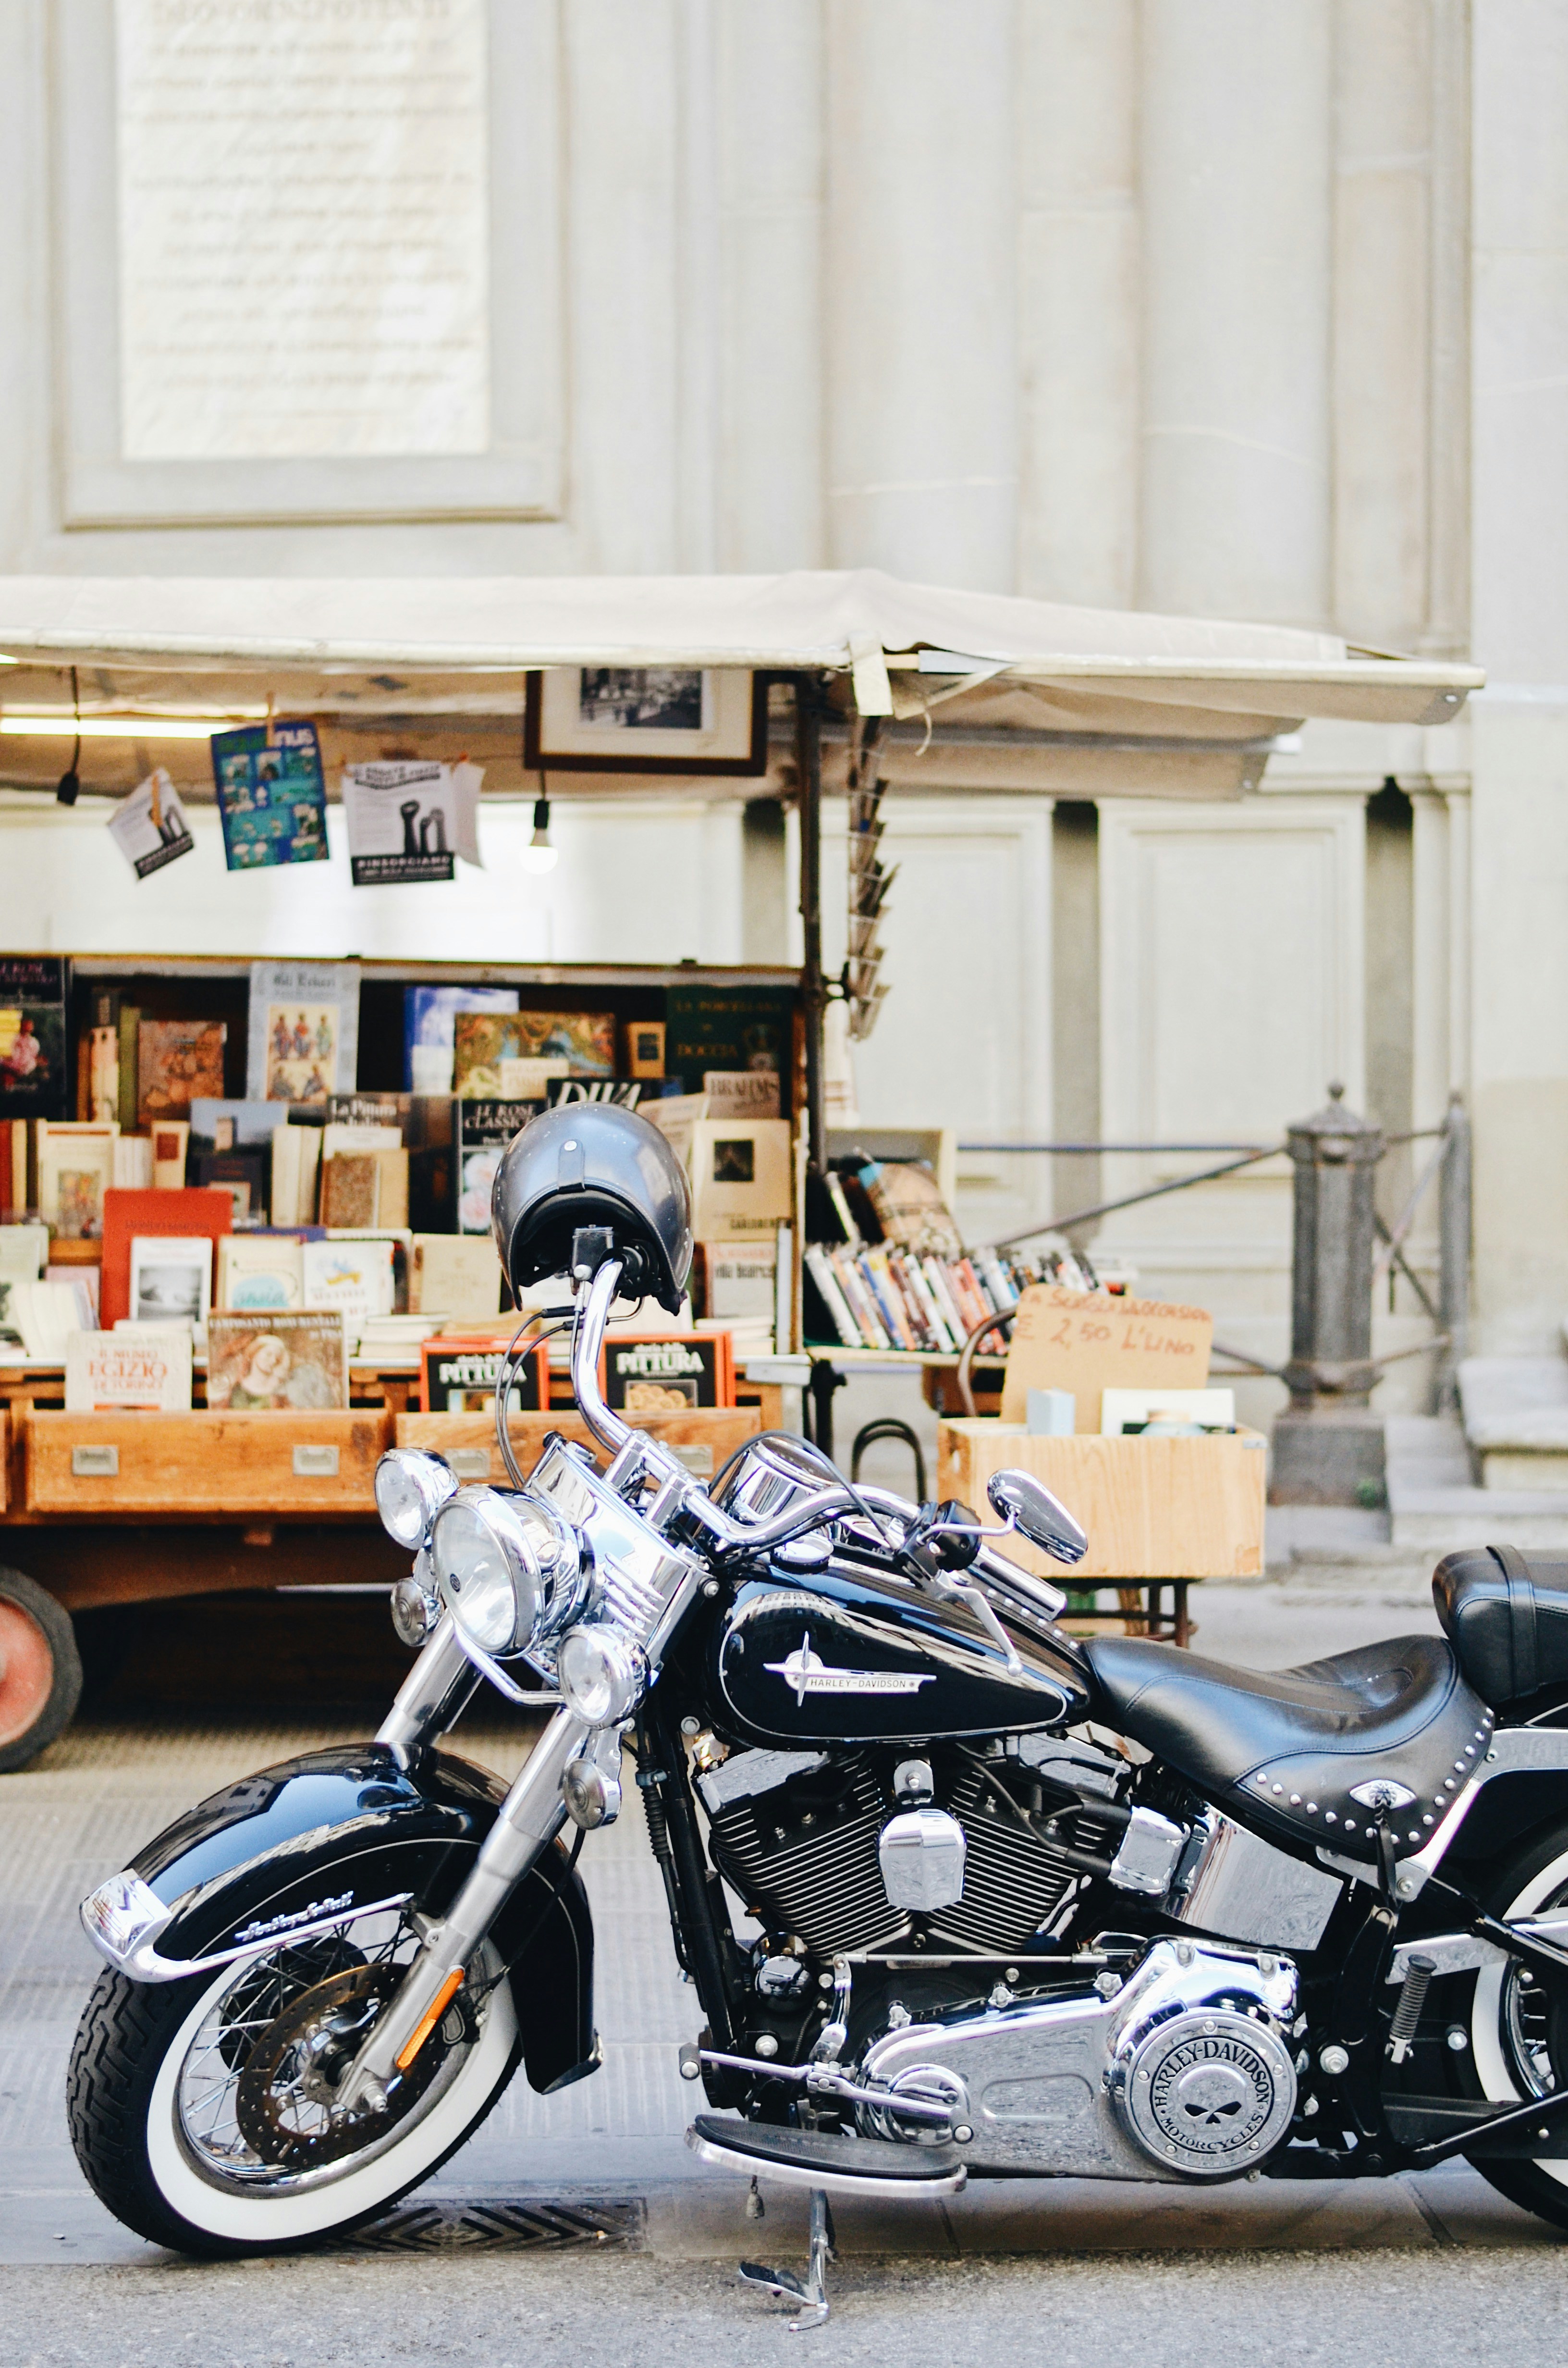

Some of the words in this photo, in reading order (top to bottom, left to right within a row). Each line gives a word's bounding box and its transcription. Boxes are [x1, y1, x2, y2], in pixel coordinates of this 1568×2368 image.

[497, 1104, 536, 1117] ROSE
[464, 1115, 531, 1129] CLASSIC
[88, 1360, 168, 1378] EGIZIO
[616, 1351, 705, 1374] PITTURA
[810, 1678, 906, 1689] HARLEY-DAVIDSON
[1155, 2041, 1269, 2107] HARLEY-DAVIDSON
[1161, 2113, 1263, 2149] MOTORCYCLES
